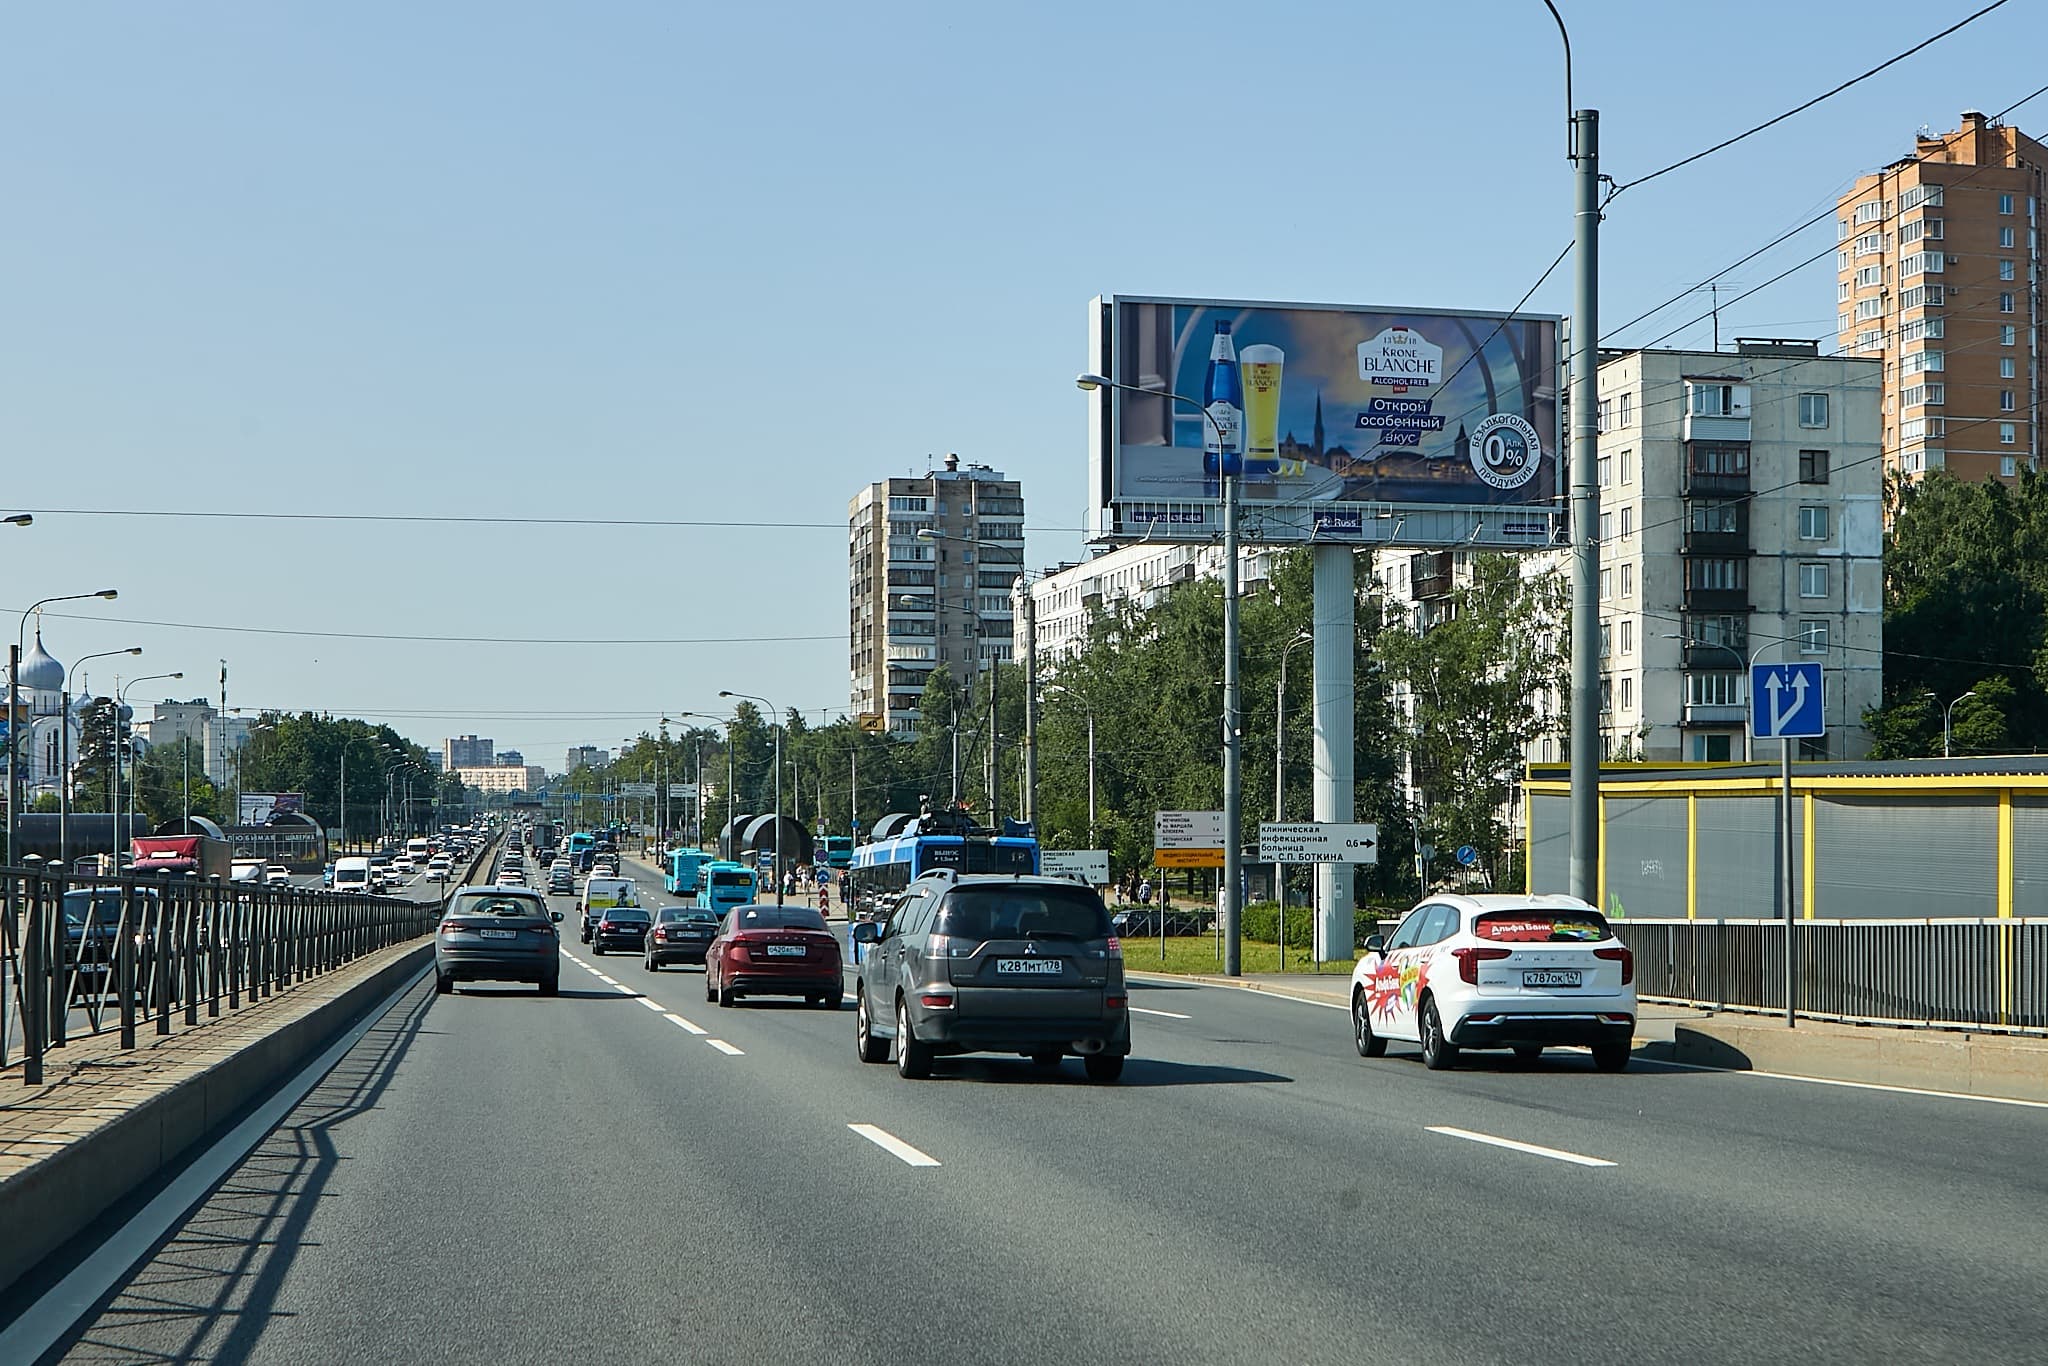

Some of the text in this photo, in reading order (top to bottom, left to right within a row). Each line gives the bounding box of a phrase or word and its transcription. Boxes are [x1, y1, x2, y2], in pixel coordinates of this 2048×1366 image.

[1364, 357, 1436, 374] BLANCHE
[1374, 378, 1408, 386] ALCOHOL
[1374, 399, 1426, 414] Открой
[1360, 414, 1440, 429] особенный
[1472, 416, 1538, 450] БЕЗАЛКОГОЛЬНАЯ
[1385, 433, 1416, 445] вкус
[1478, 466, 1534, 488] ПРОДУКЦИЯ
[1261, 835, 1328, 844] инфекционная
[1345, 840, 1359, 848] 0,6
[1261, 844, 1304, 852] больница
[1278, 853, 1296, 861] С.П.
[1298, 853, 1344, 861] БОТКИНА
[1044, 961, 1060, 969] 178
[1565, 972, 1579, 981] 147
